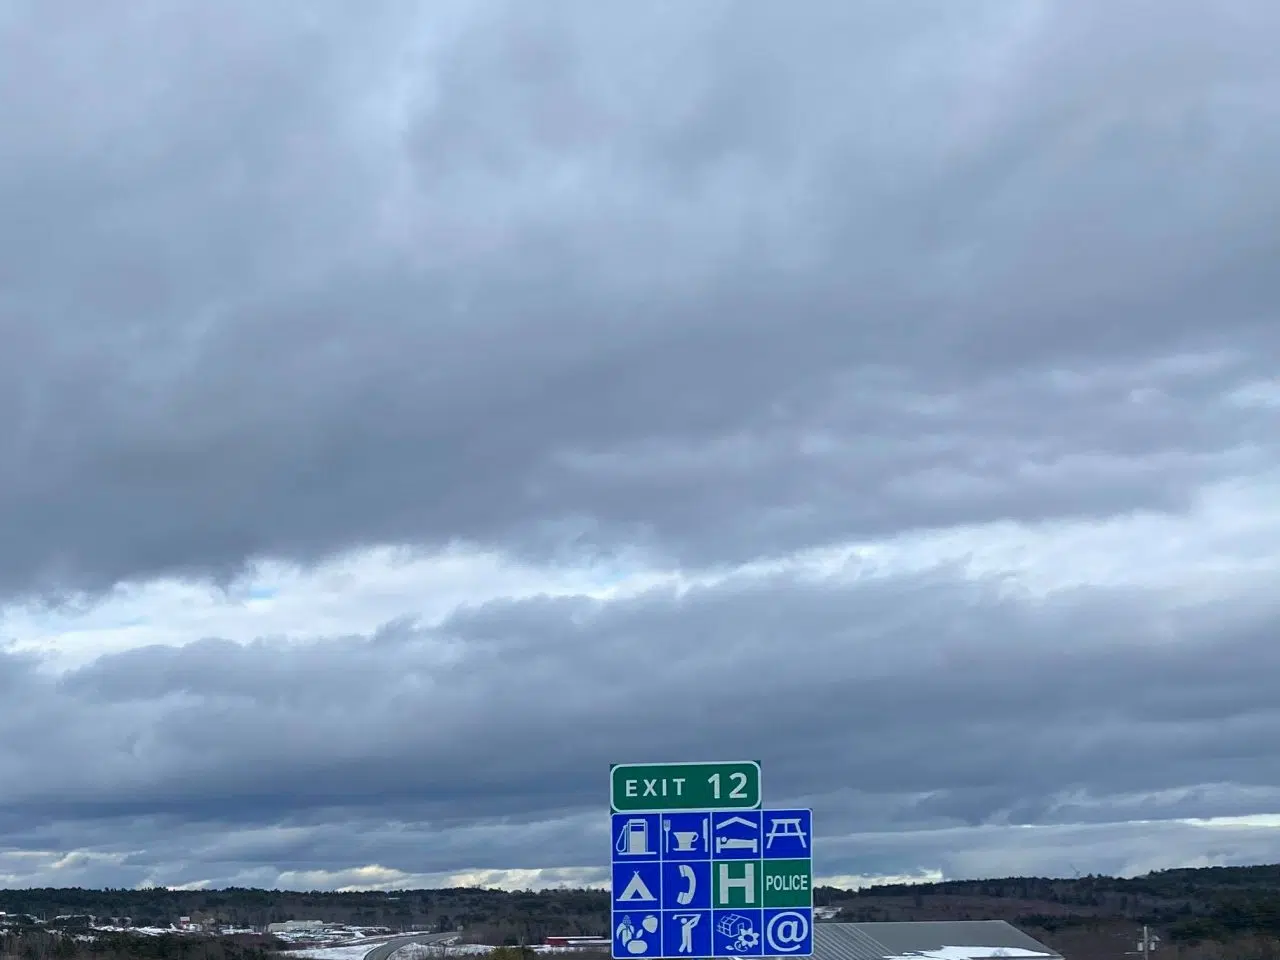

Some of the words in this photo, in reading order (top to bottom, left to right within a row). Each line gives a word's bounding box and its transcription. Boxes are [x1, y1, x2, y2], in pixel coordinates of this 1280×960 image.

[625, 779, 686, 797] EXIT
[708, 772, 748, 799] 12
[719, 863, 755, 904] H
[766, 874, 808, 891] POLICE
[766, 911, 808, 952] @
